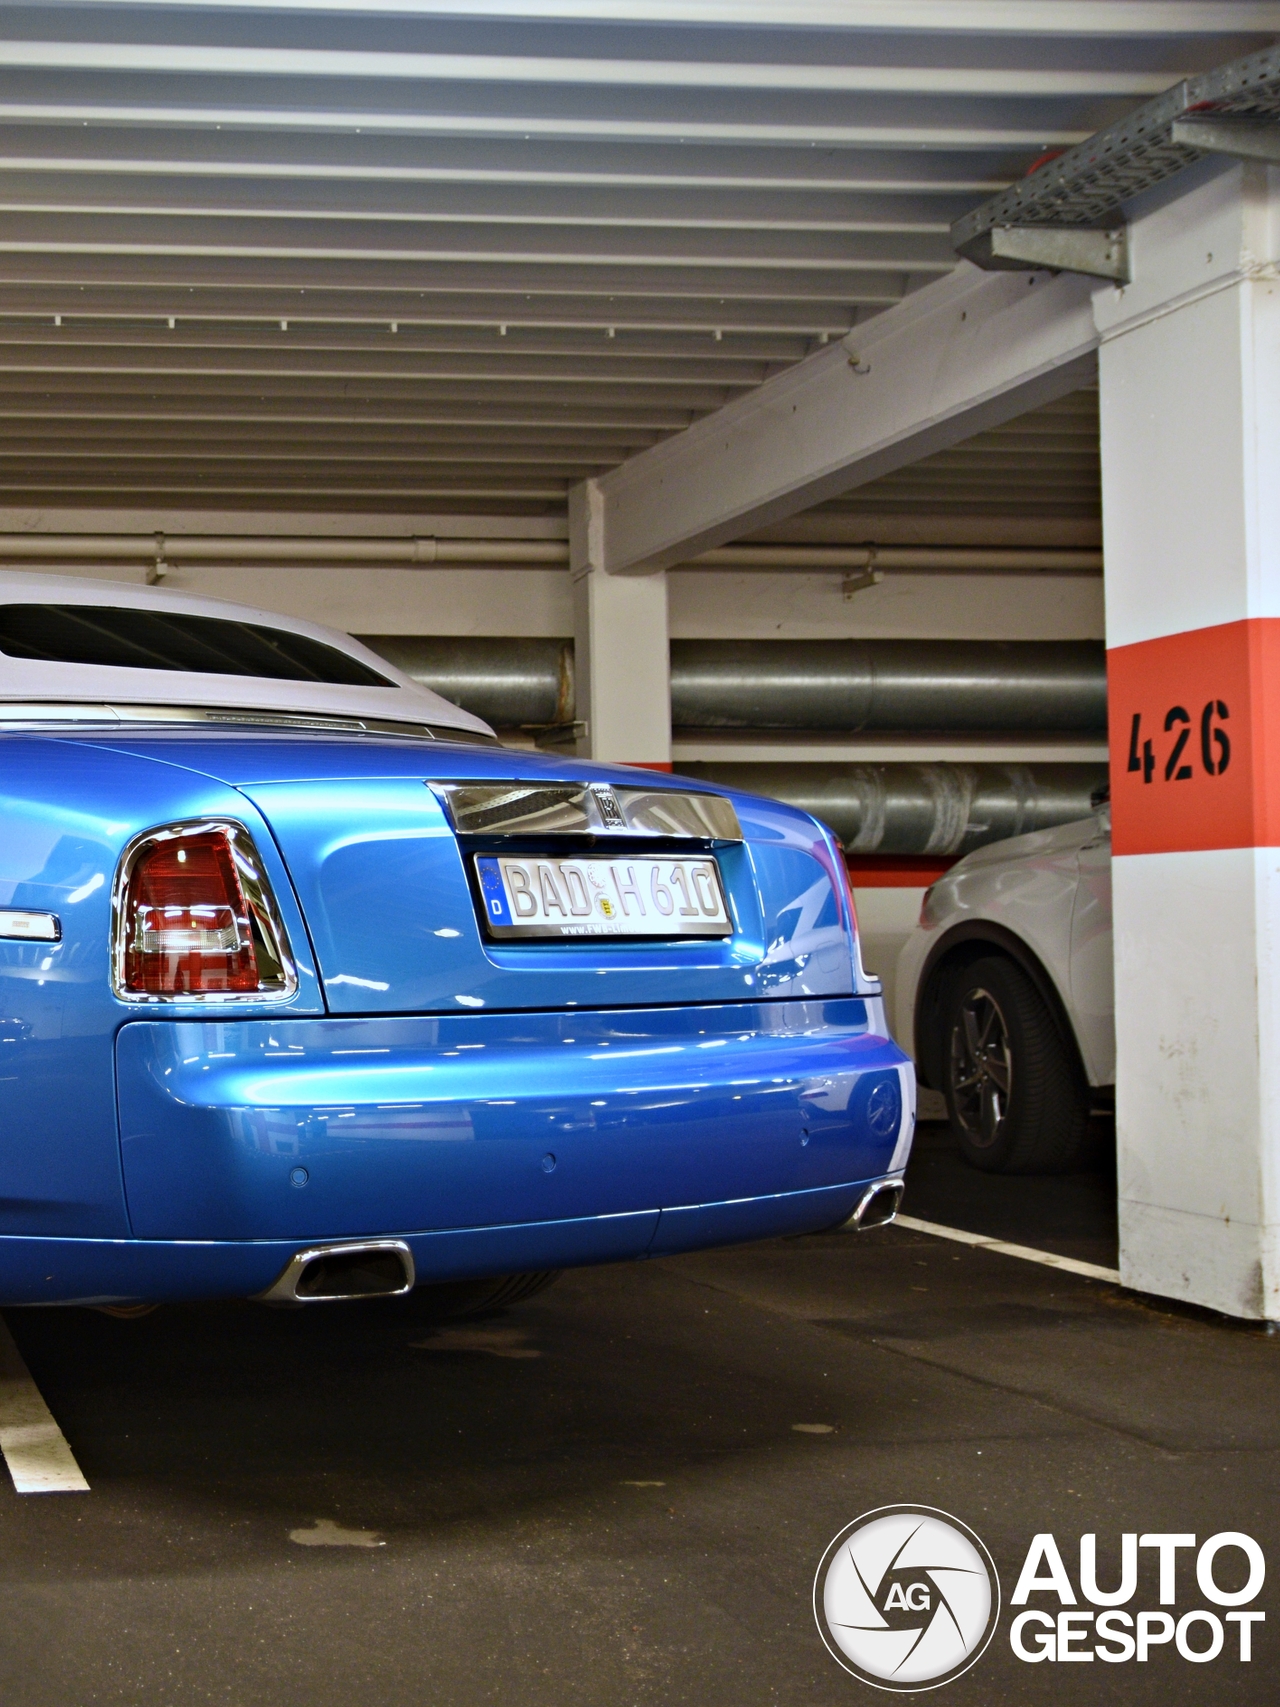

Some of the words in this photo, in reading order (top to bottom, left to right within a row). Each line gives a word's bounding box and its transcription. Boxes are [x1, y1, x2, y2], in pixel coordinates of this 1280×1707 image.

[1127, 699, 1231, 784] 426
[491, 899, 502, 915] D
[505, 864, 592, 916] BAD
[611, 865, 646, 916] H
[651, 866, 719, 916] 610
